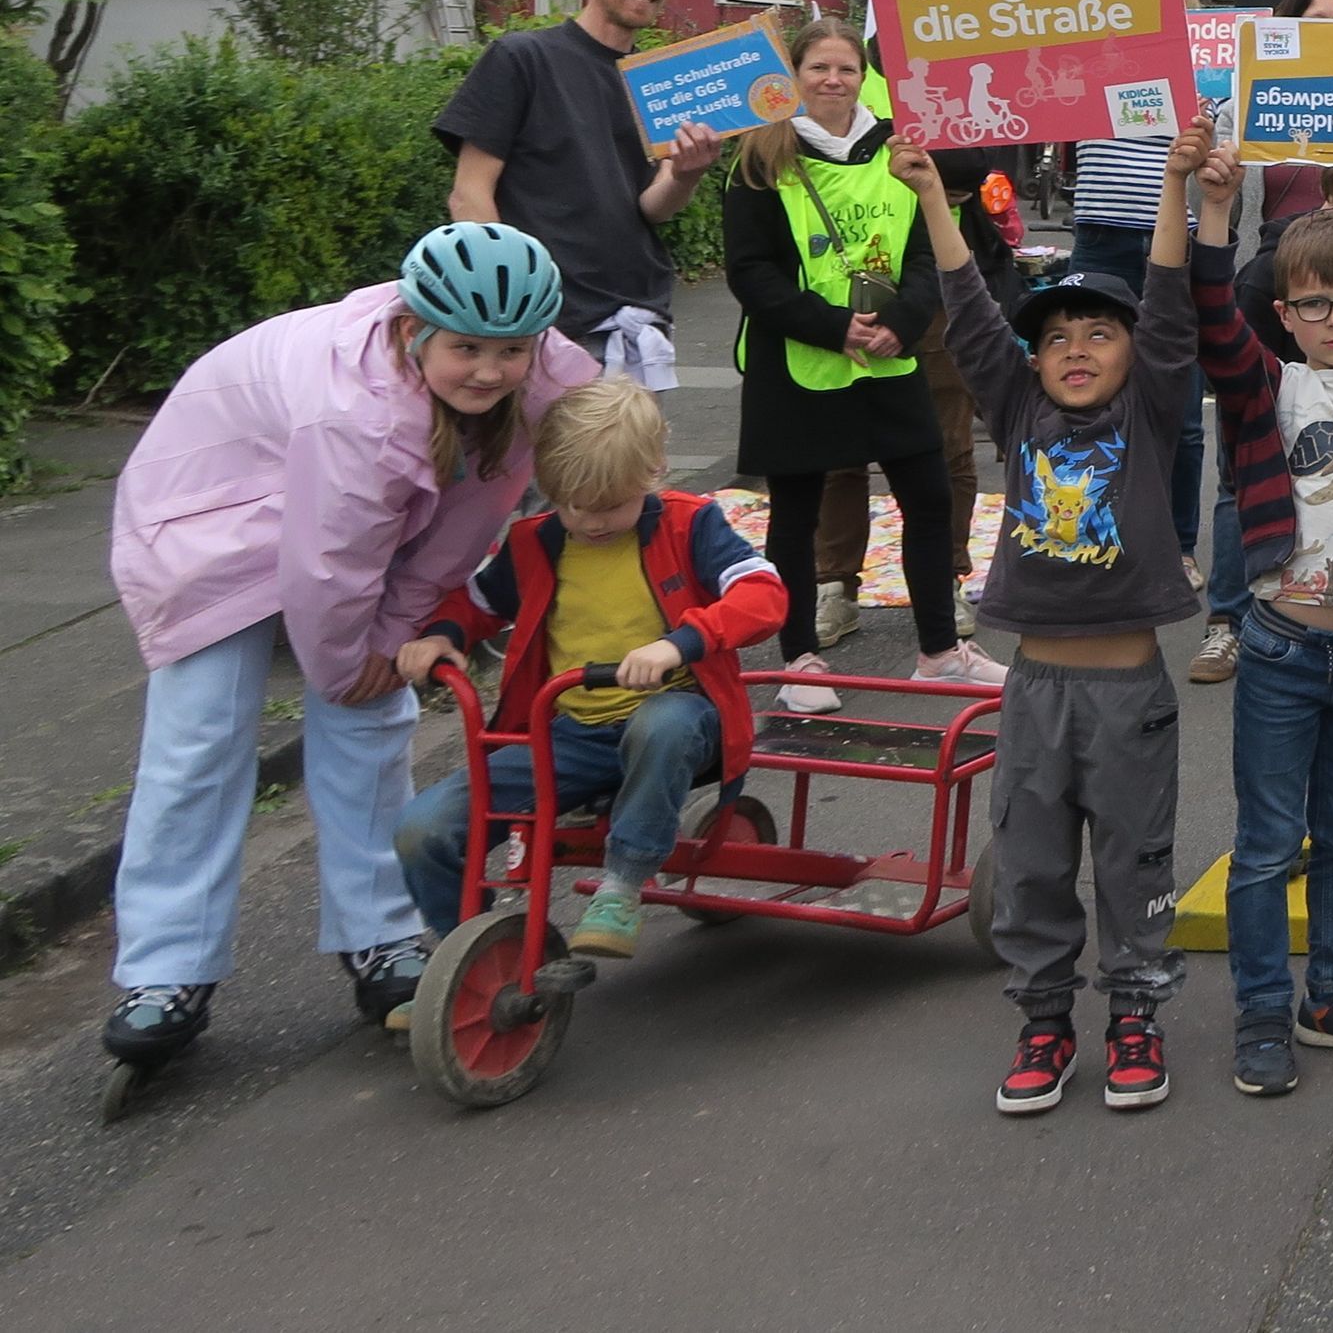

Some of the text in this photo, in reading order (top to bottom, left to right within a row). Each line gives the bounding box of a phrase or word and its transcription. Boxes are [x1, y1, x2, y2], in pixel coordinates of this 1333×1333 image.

[913, 6, 981, 42] die
[641, 51, 761, 96] Eine Schulstraße
[647, 78, 728, 113] für die GGS
[1117, 87, 1163, 101] KIDICAL
[1131, 97, 1164, 109] MASS
[653, 93, 743, 129] Peter-Lustig
[1255, 113, 1285, 132] für
[839, 223, 869, 243] ASS
